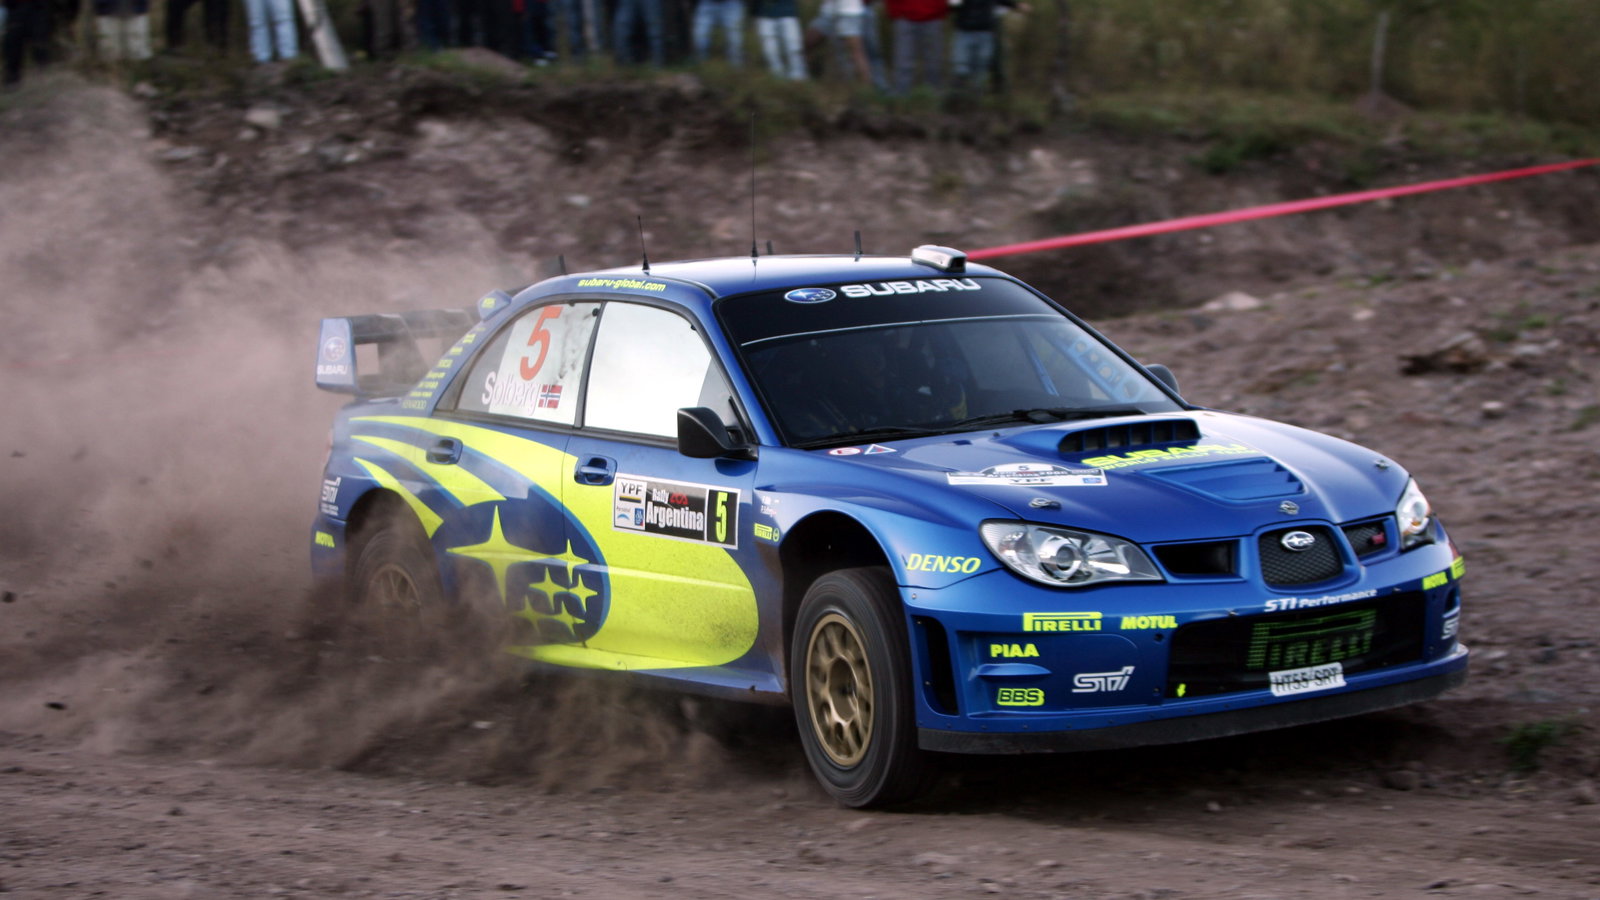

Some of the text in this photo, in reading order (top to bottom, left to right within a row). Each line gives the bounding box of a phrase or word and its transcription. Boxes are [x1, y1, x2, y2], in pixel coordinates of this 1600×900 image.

[578, 278, 666, 291] subaru-global.com
[841, 278, 982, 298] SUBARU
[519, 305, 564, 381] 5
[317, 364, 348, 375] SUBARU
[481, 371, 541, 416] Solberg
[1081, 444, 1248, 468] SUBARU
[620, 482, 643, 495] YPF
[652, 488, 669, 504] Rally
[646, 501, 704, 531] Argentina
[715, 491, 728, 543] 5
[906, 553, 981, 574] DENSO
[1263, 589, 1377, 613] STI Performance
[1023, 611, 1102, 632] PIRELLI
[1120, 615, 1178, 630] MOTUL
[1246, 609, 1376, 670] PIRELLI
[990, 643, 1040, 658] PIAA
[998, 687, 1043, 704] BBS
